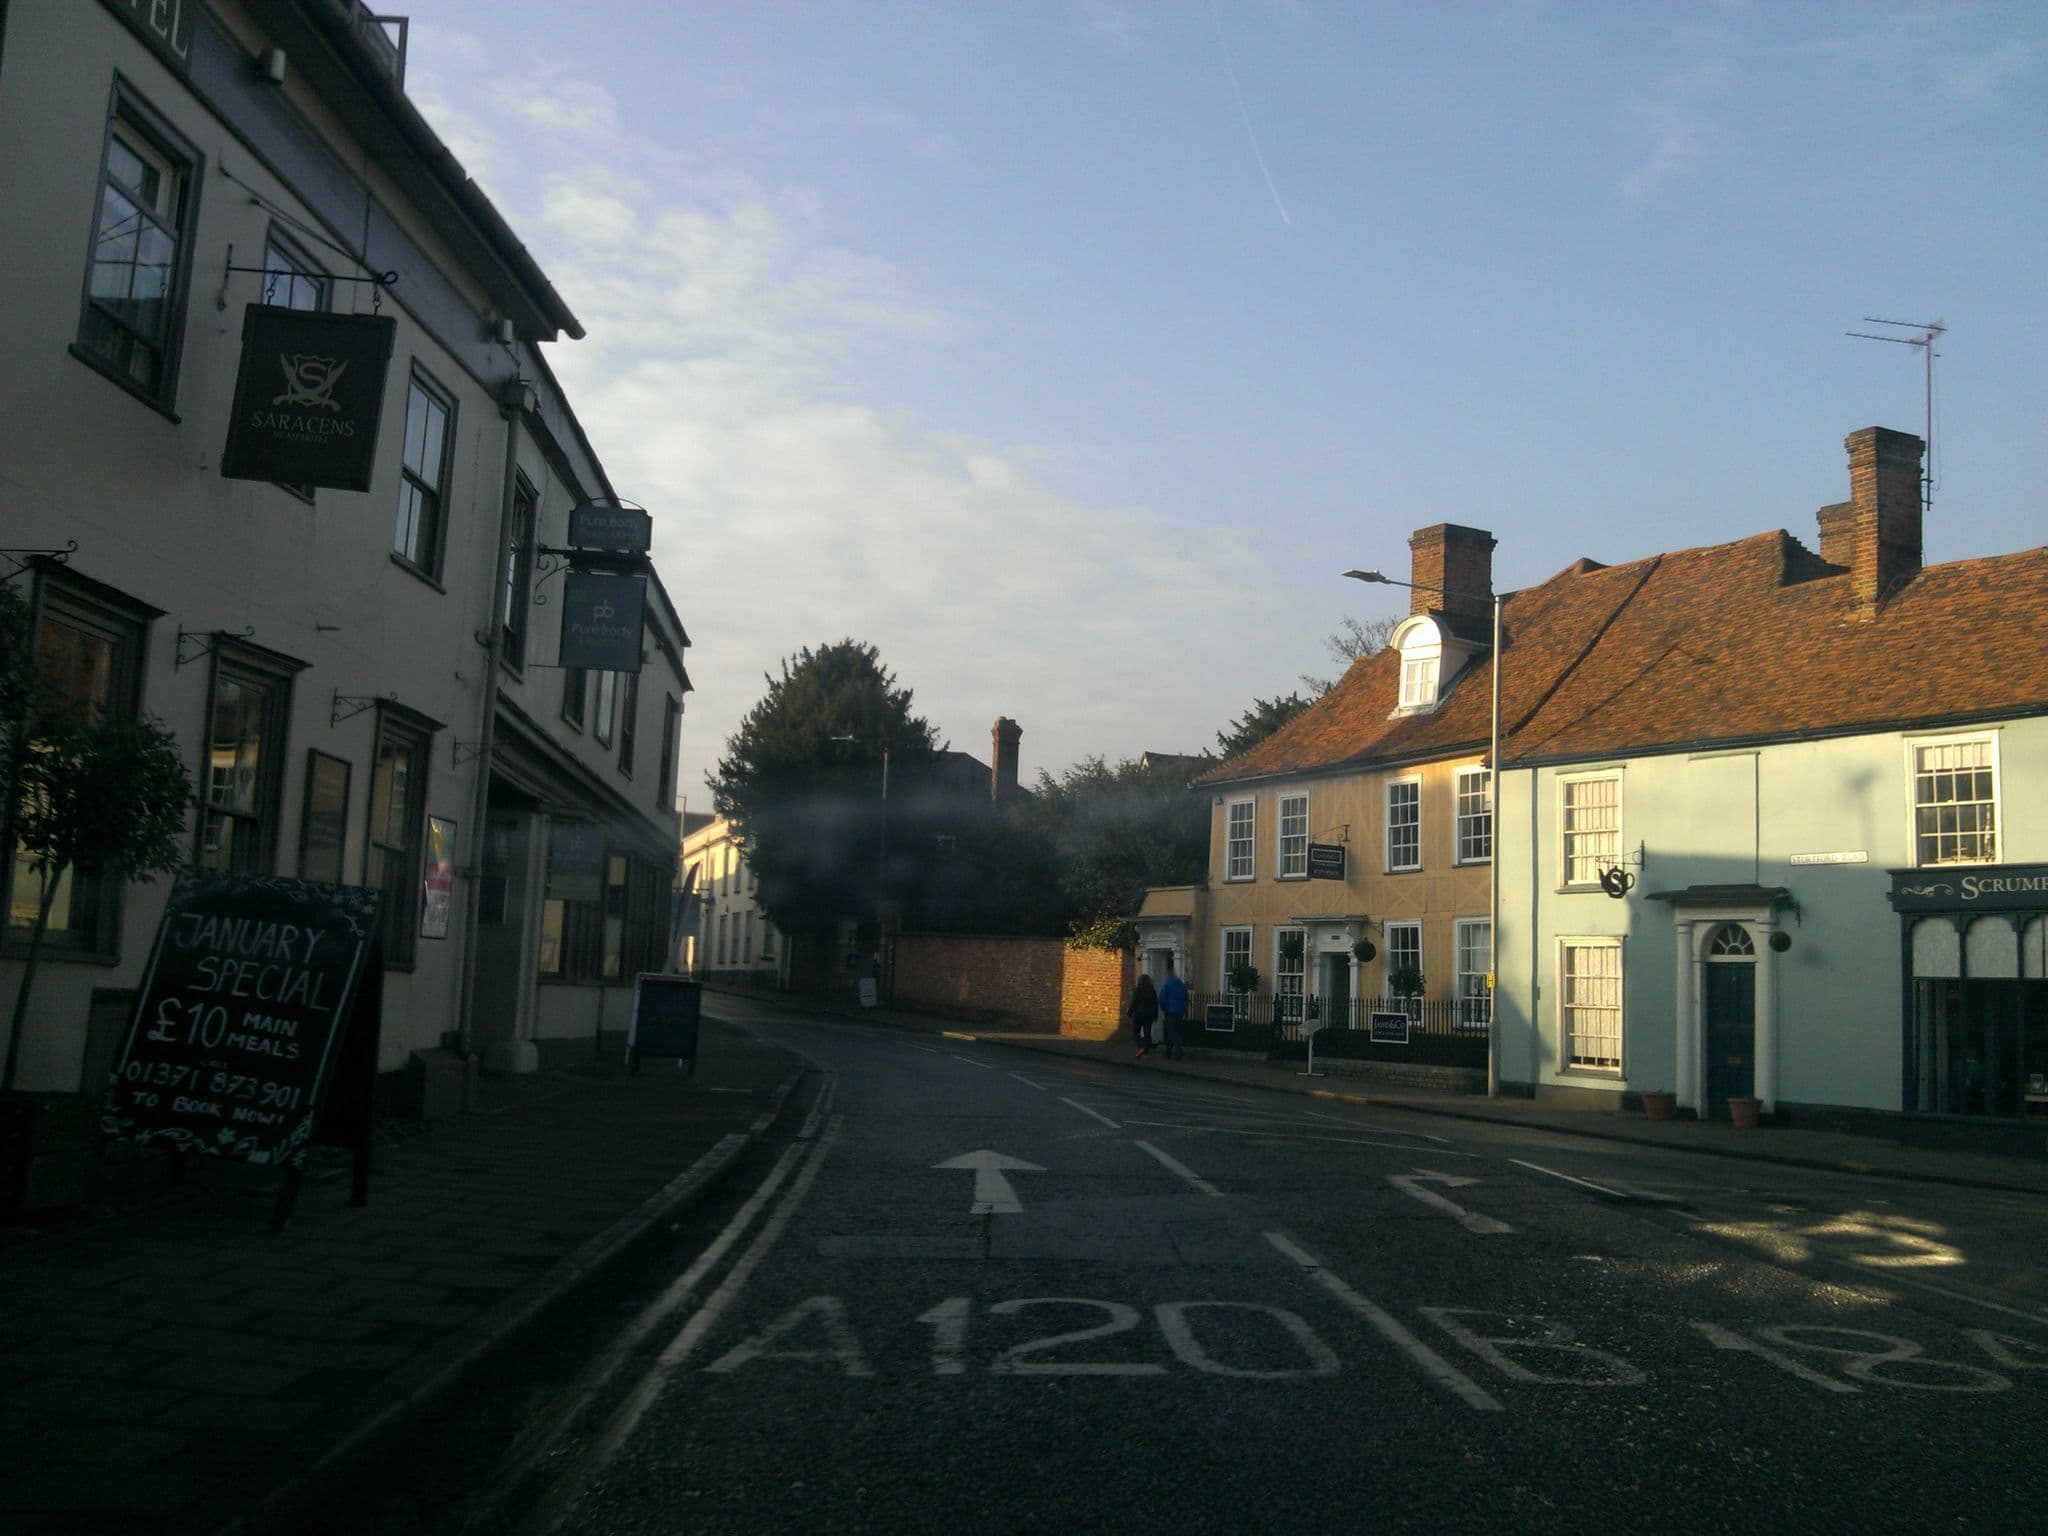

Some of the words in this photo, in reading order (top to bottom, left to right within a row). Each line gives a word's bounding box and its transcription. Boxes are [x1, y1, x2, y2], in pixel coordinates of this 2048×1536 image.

[251, 411, 355, 436] SARACENS
[174, 912, 326, 964] JANUARY
[187, 956, 330, 1012] SPECIAL
[146, 998, 229, 1048] £10
[243, 1011, 298, 1037] MAIN
[226, 1031, 299, 1059] MEALS
[126, 1060, 199, 1091] 01371
[131, 1091, 159, 1108] TO
[172, 1096, 221, 1118] BOOK
[702, 1296, 1341, 1378] A120
